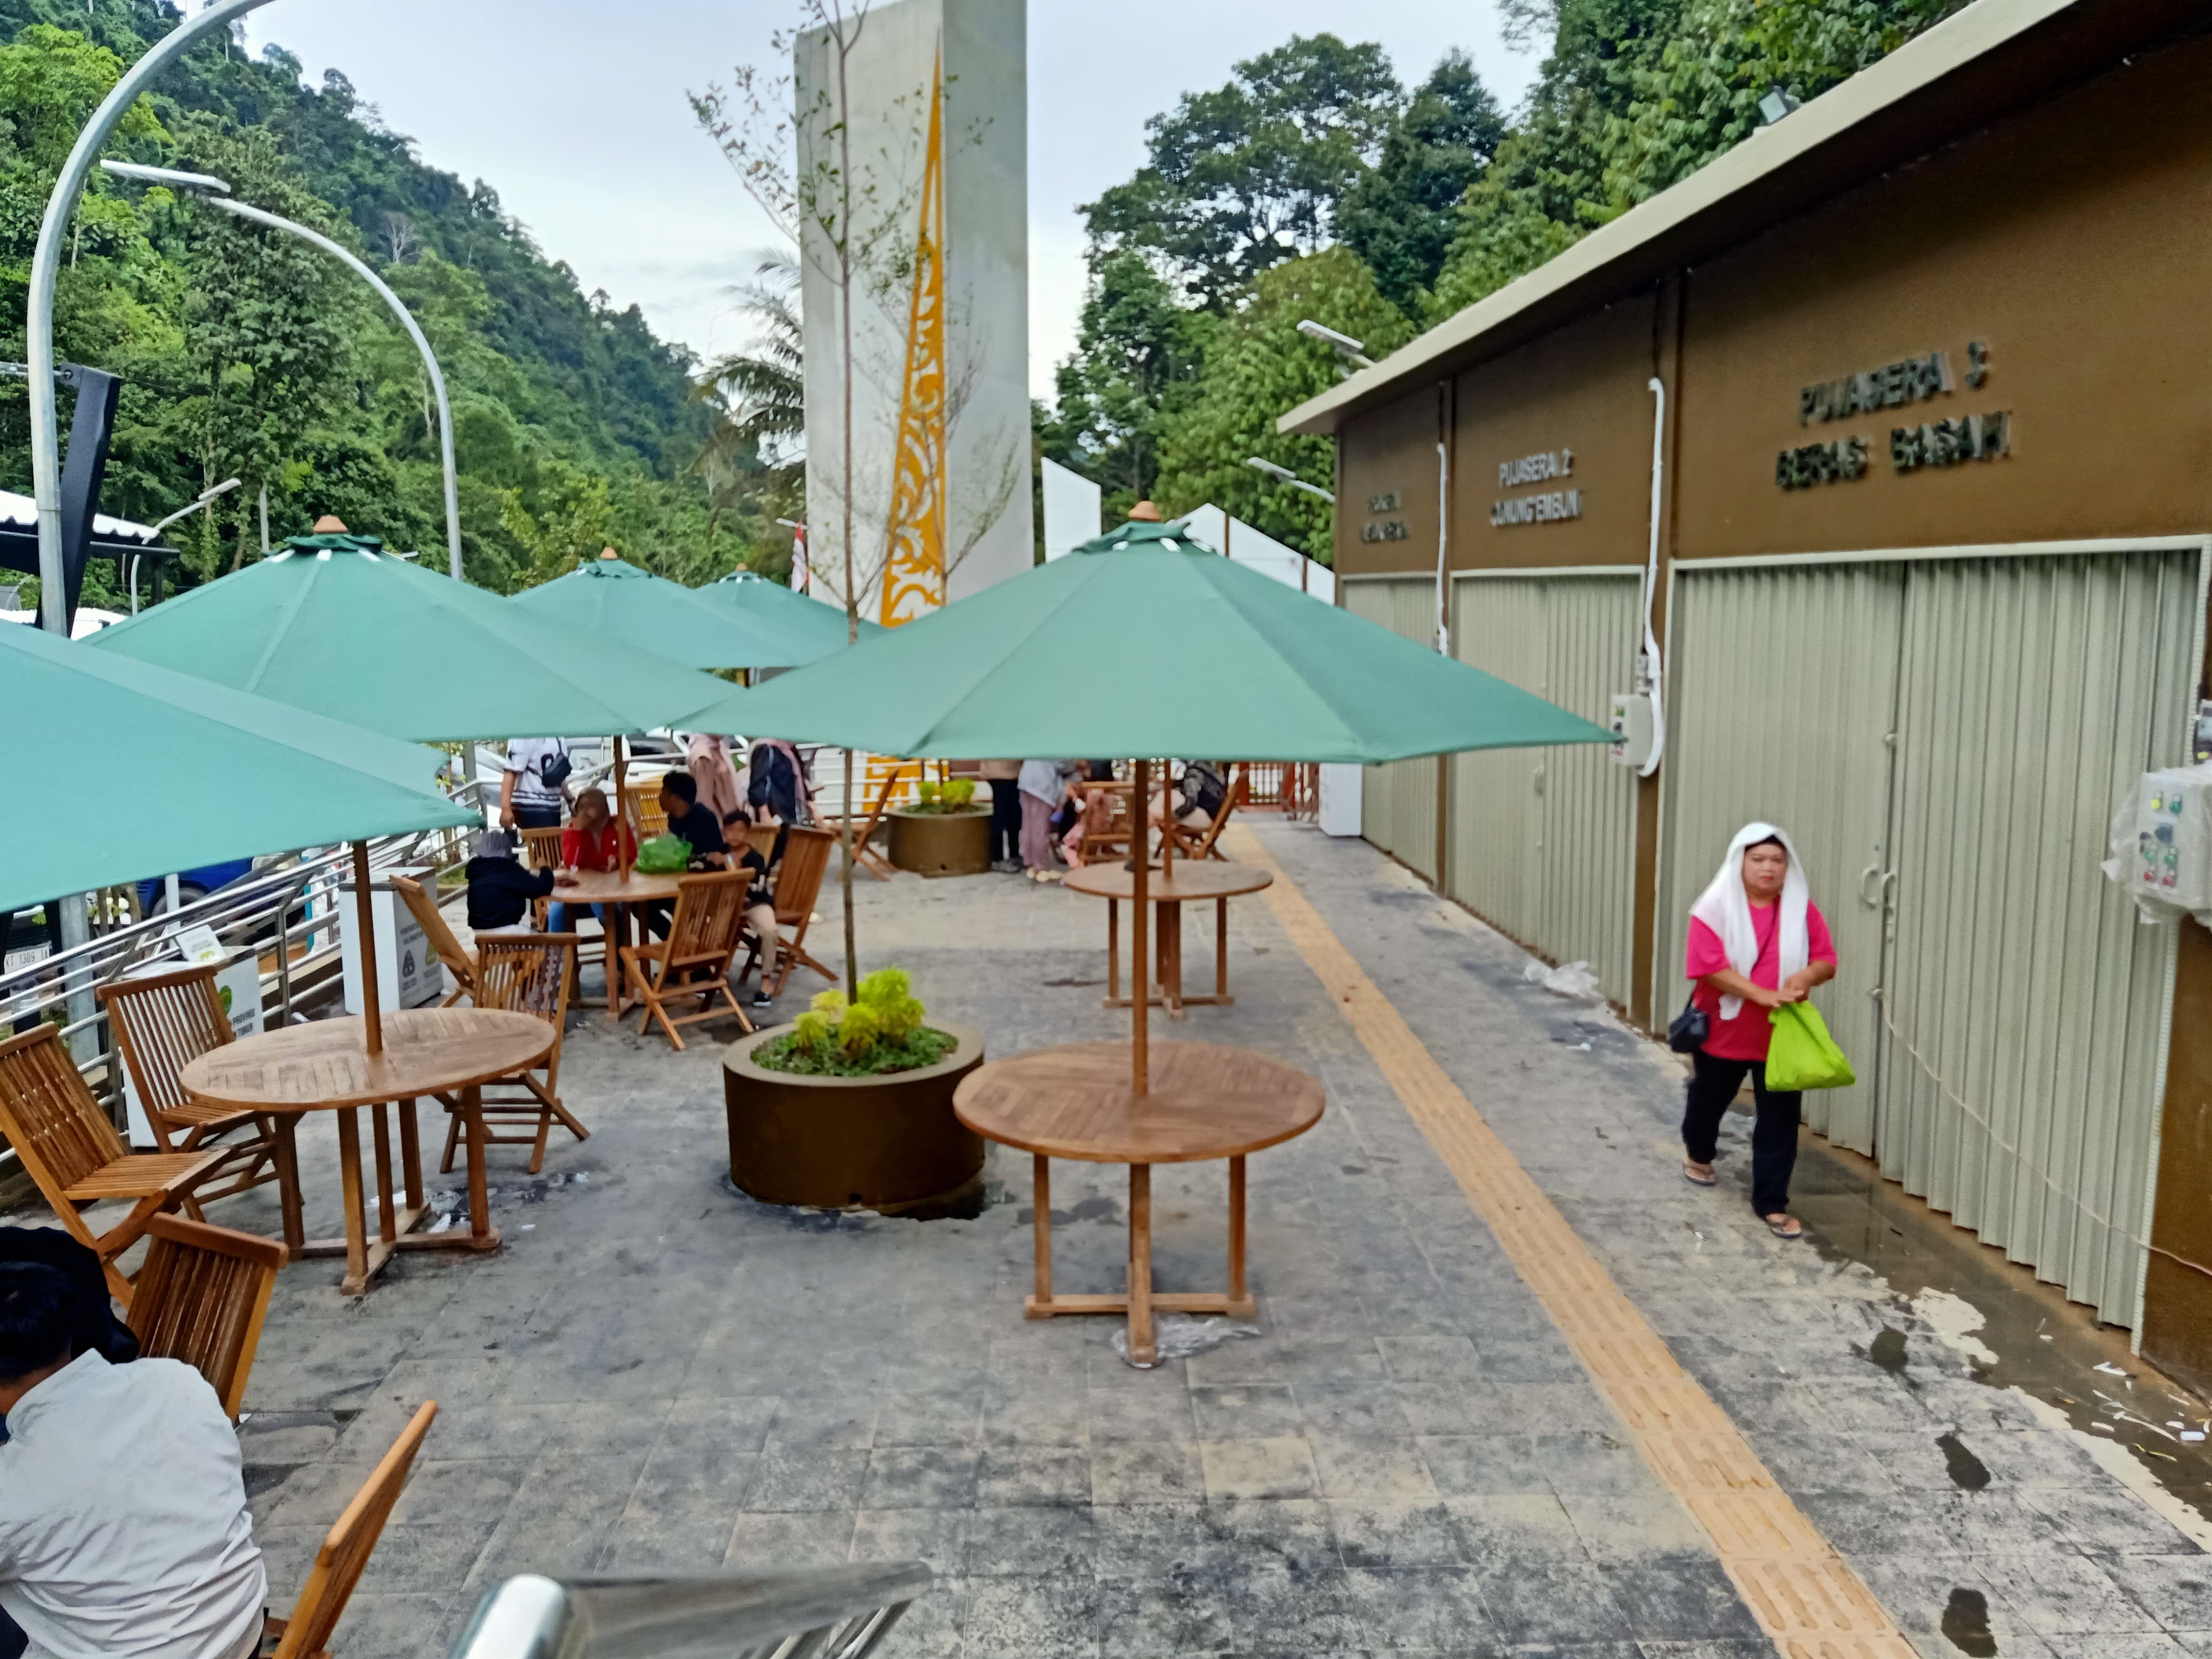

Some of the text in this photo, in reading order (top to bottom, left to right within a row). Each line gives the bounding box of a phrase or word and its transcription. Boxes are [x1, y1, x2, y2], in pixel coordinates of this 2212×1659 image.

[1562, 447, 1574, 477] 2
[6, 955, 14, 967] KT
[19, 952, 35, 964] 1309
